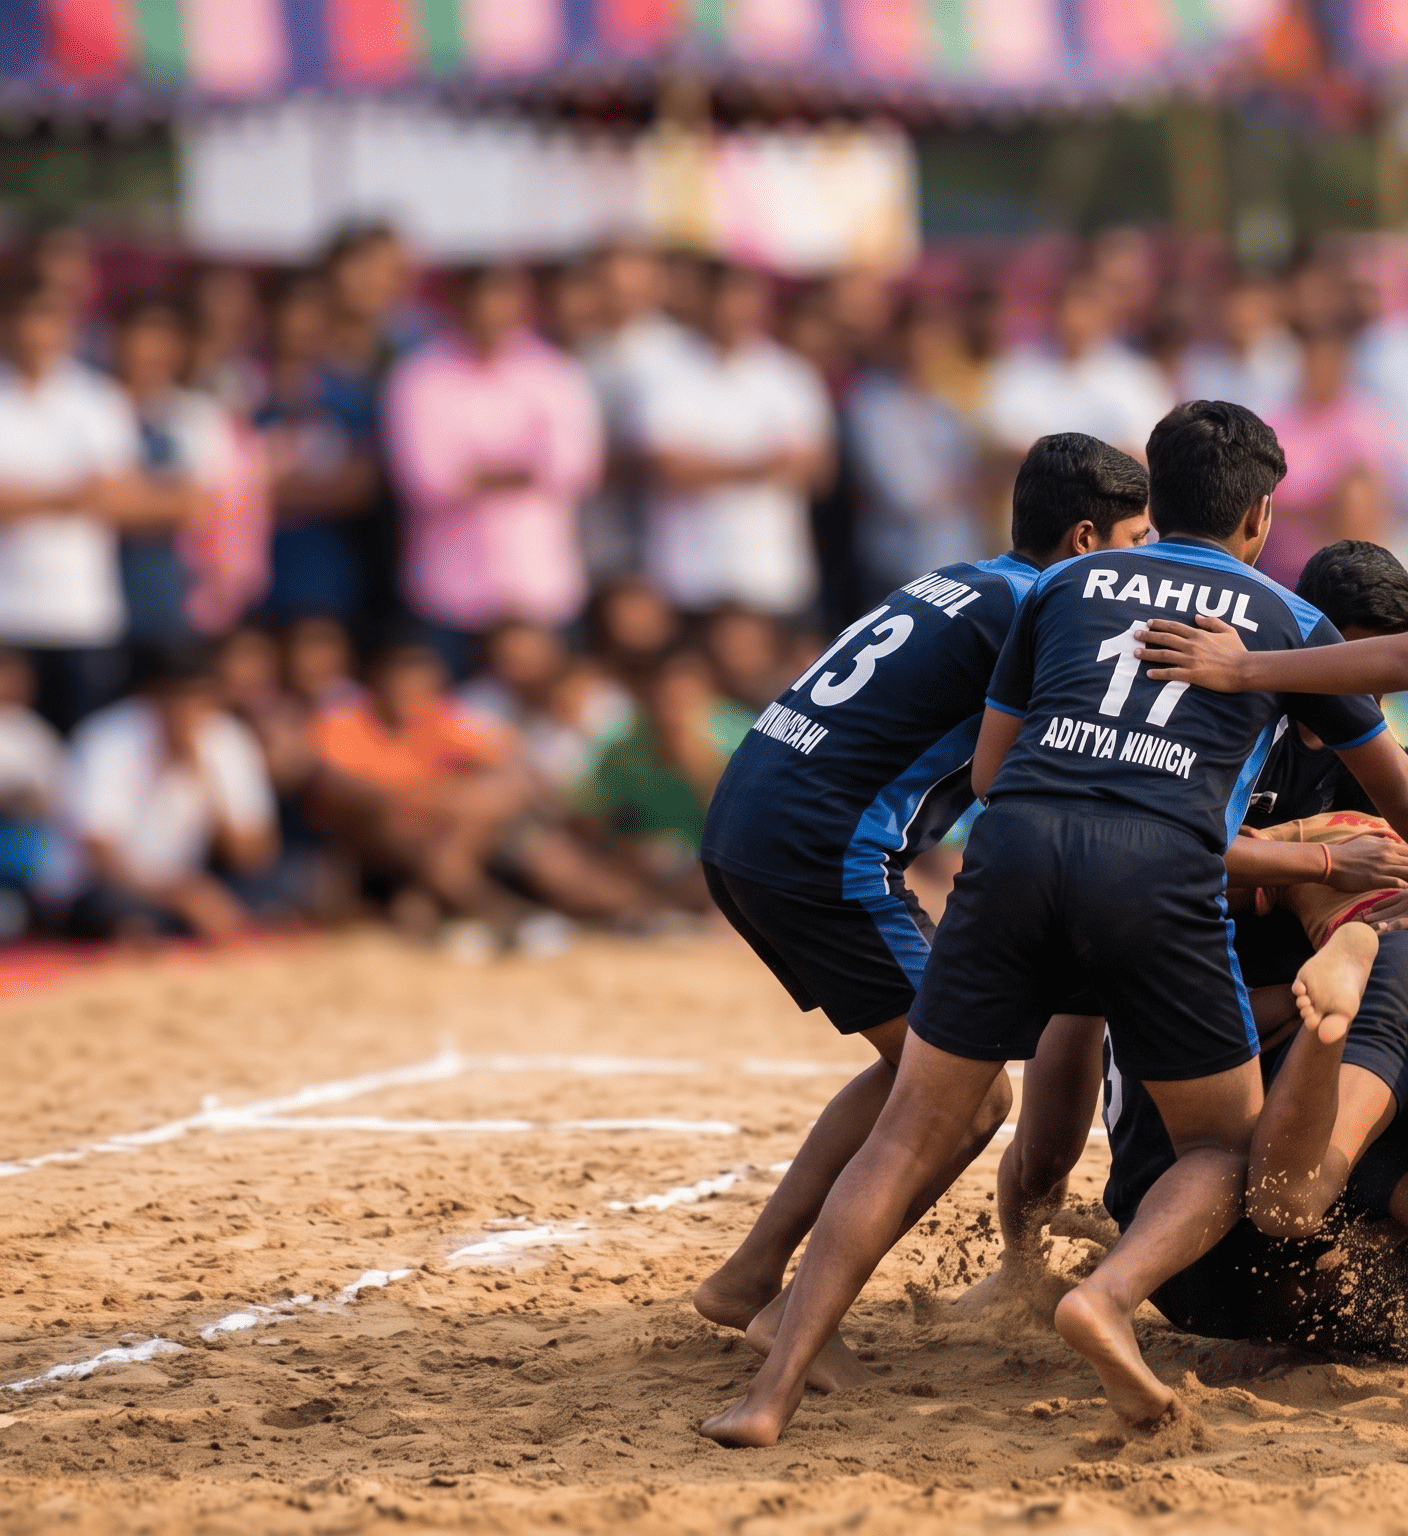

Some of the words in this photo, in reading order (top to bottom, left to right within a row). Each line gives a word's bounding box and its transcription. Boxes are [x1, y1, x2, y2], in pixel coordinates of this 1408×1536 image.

[1082, 569, 1259, 633] RAHUL
[790, 604, 914, 707] 13
[1039, 716, 1118, 758] ADITYA
